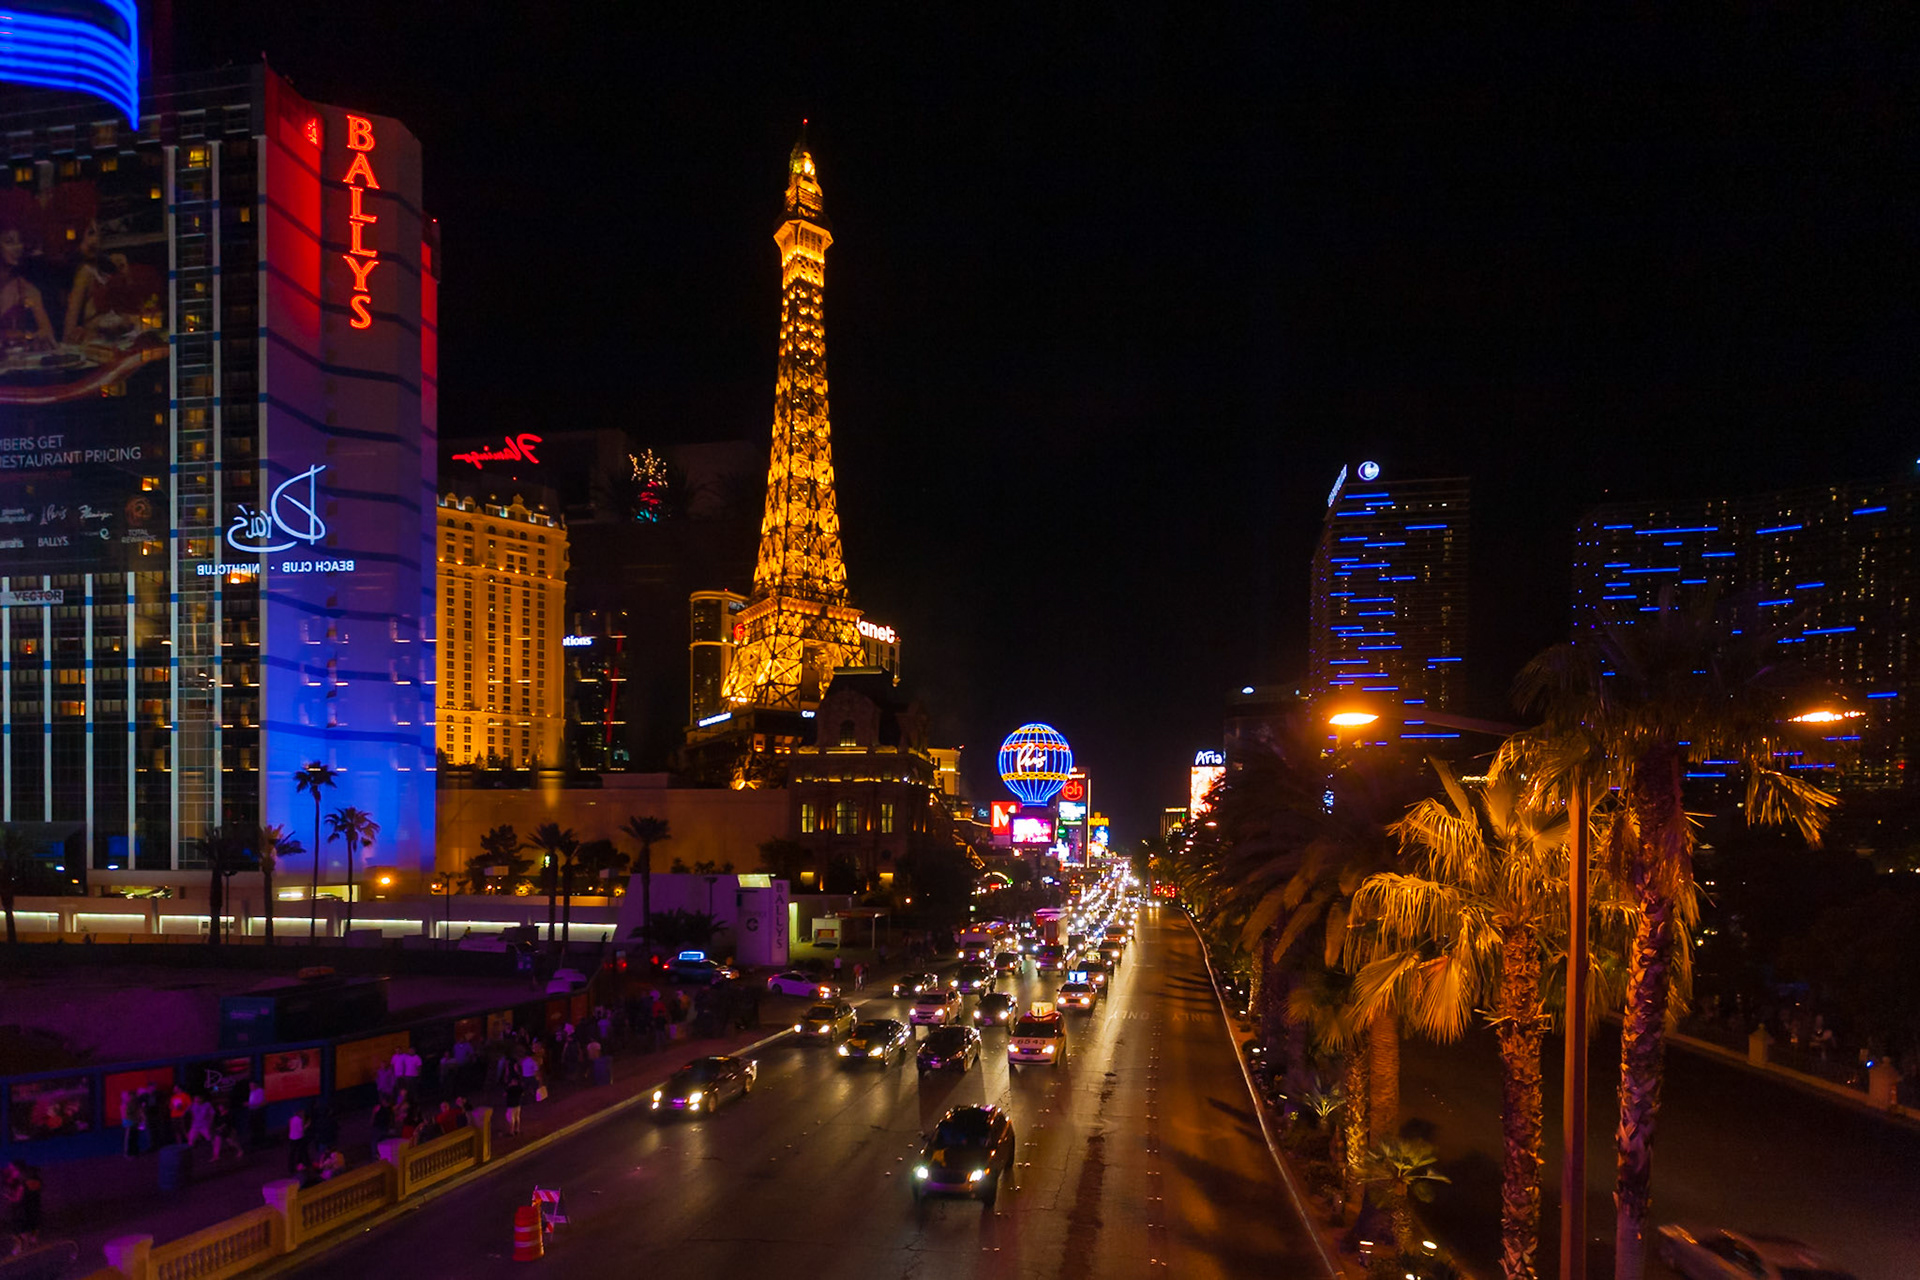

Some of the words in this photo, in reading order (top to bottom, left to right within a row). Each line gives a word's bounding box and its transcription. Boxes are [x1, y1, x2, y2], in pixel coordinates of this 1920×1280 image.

[37, 434, 64, 448] GET
[84, 446, 142, 463] PRICING
[13, 590, 62, 602] VECTOR
